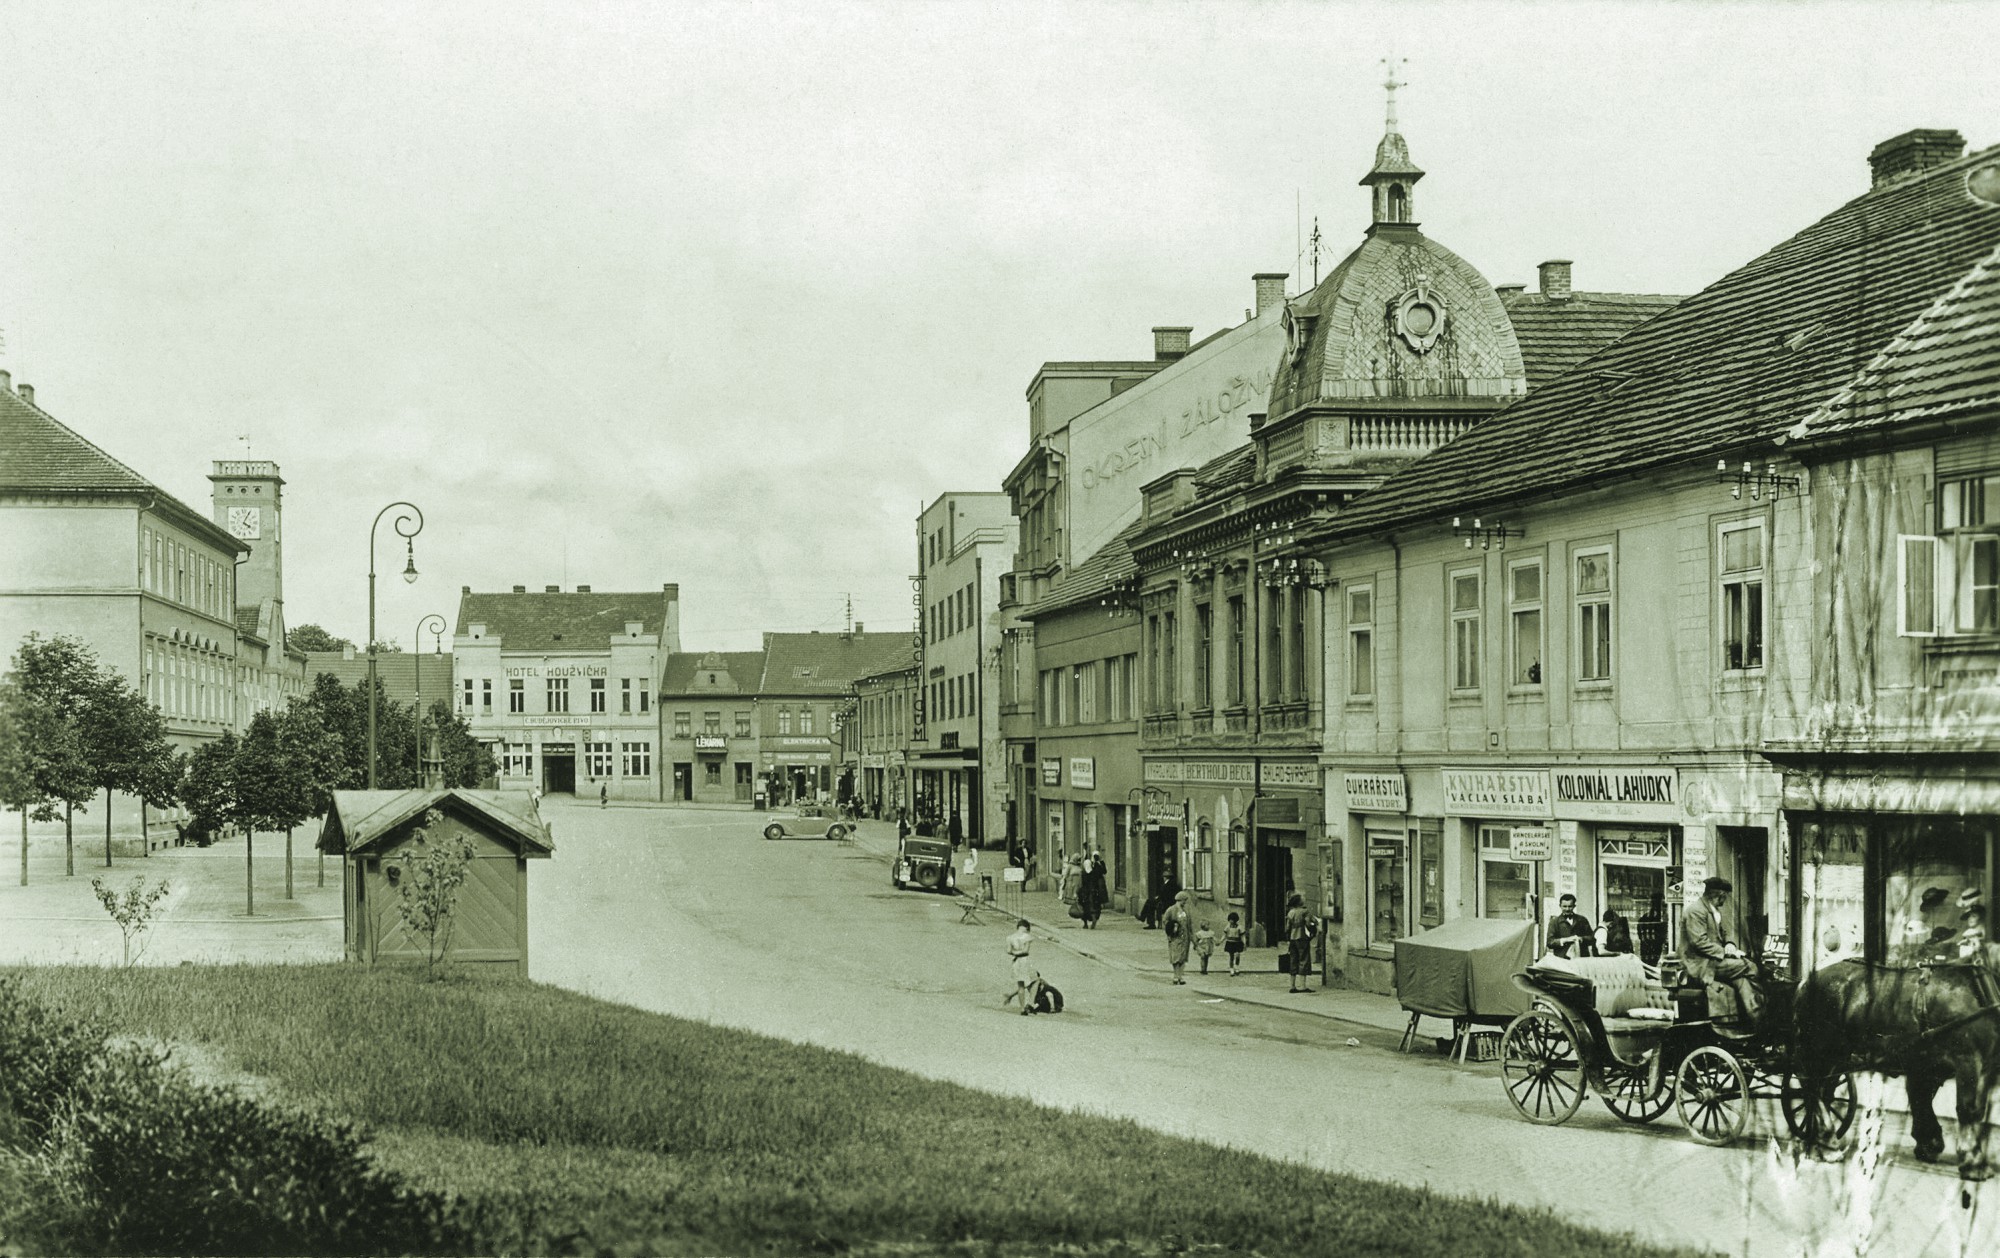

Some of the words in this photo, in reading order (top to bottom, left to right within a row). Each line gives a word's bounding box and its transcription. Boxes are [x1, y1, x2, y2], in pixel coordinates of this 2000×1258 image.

[506, 667, 539, 677] HOTEL
[696, 735, 726, 748] LÉKÁRNA
[1186, 764, 1228, 780] BERTHOLD
[1557, 769, 1612, 801] KOLONIÁL
[1352, 798, 1374, 807] KARLA
